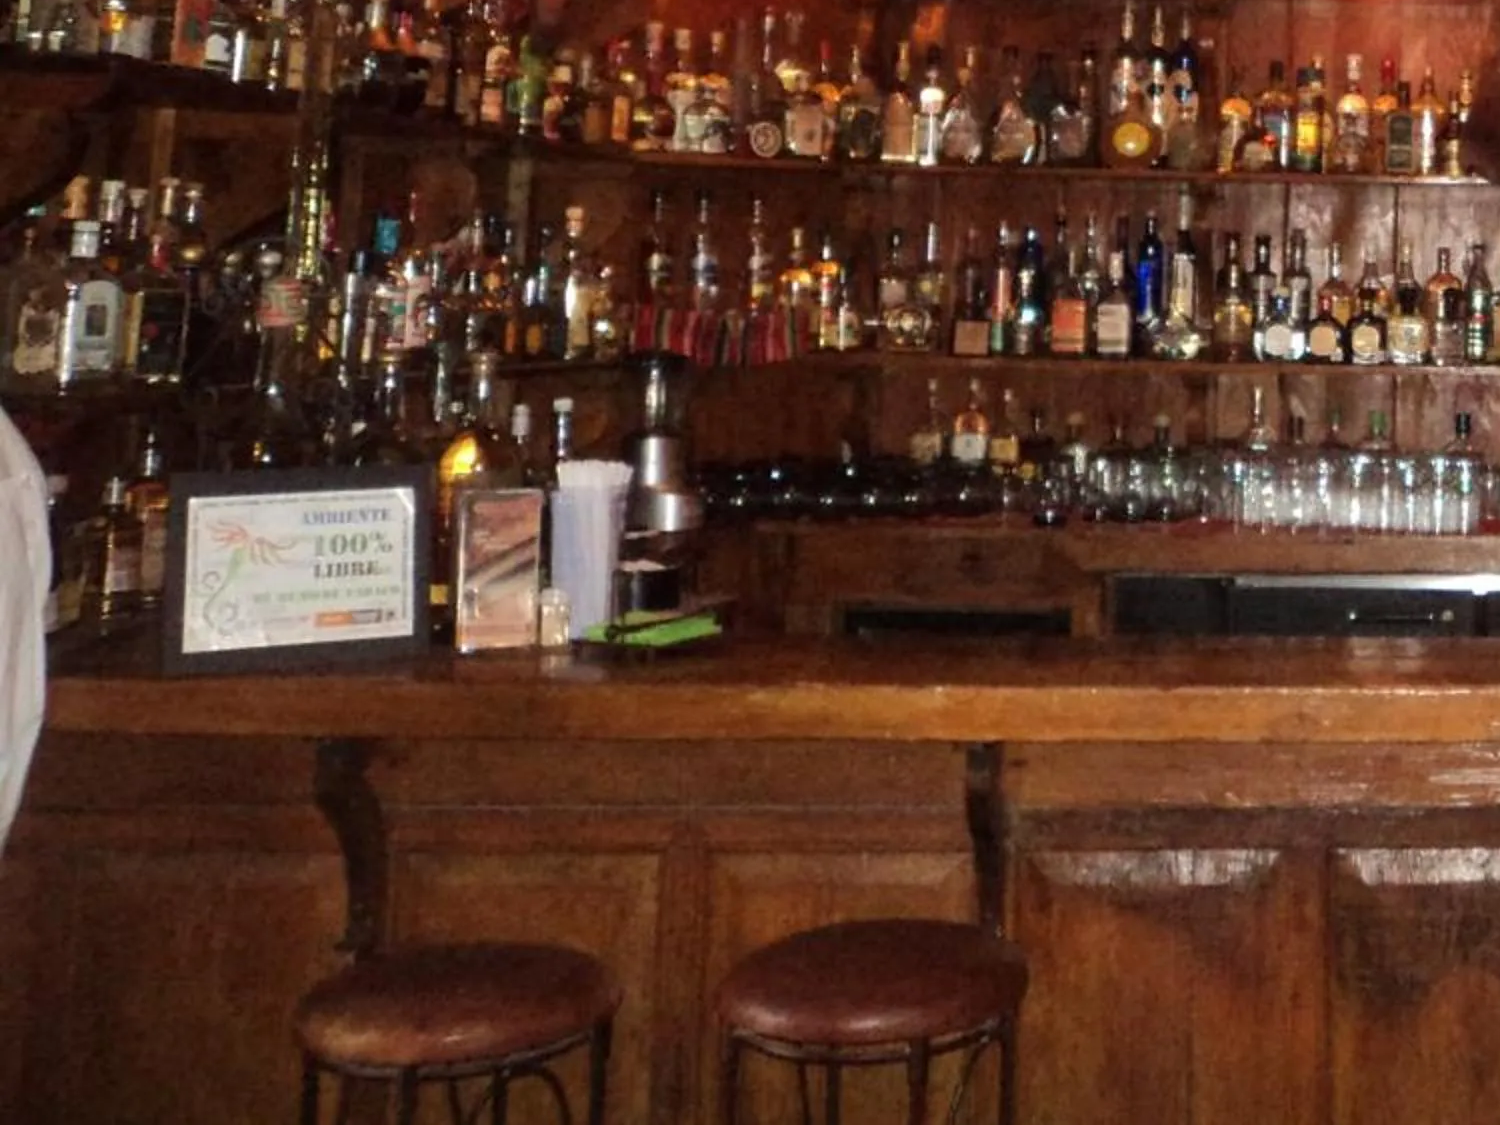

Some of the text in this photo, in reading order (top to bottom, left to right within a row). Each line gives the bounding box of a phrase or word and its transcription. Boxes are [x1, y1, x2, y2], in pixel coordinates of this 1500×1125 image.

[302, 507, 391, 525] AMBIENTE
[314, 530, 394, 556] 100%
[313, 559, 383, 579] LIBRE
